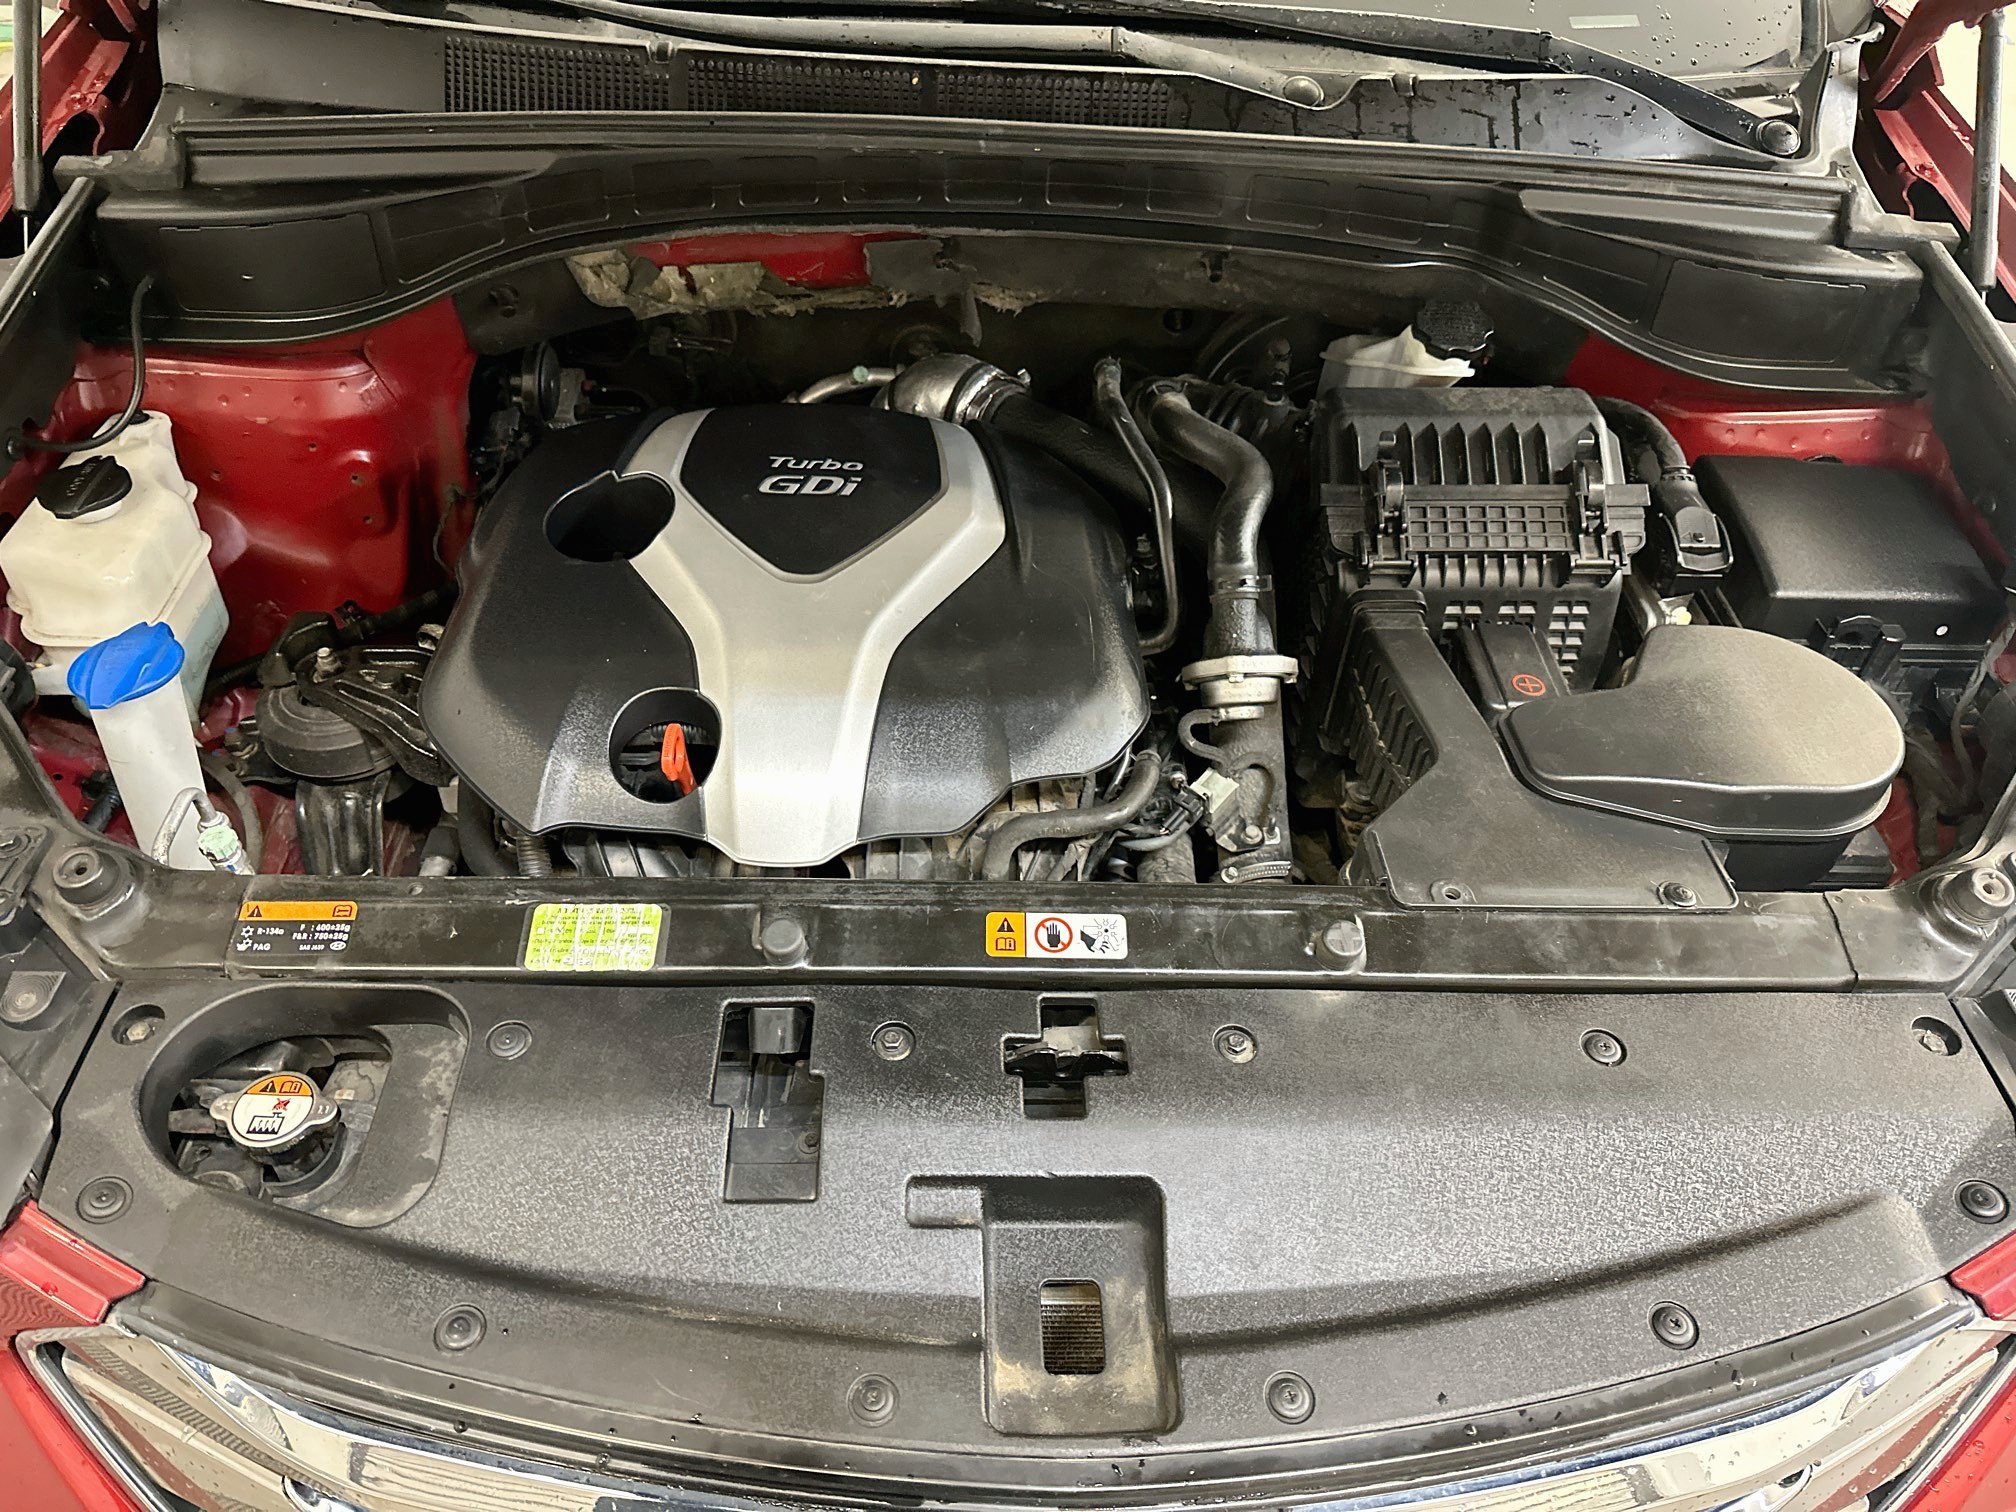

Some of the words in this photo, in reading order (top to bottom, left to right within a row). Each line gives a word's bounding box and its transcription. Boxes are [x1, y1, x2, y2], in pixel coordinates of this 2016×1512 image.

[769, 456, 864, 471] Turbo
[758, 475, 862, 496] GDi
[256, 927, 285, 935] R-134a
[252, 943, 271, 951] PAG
